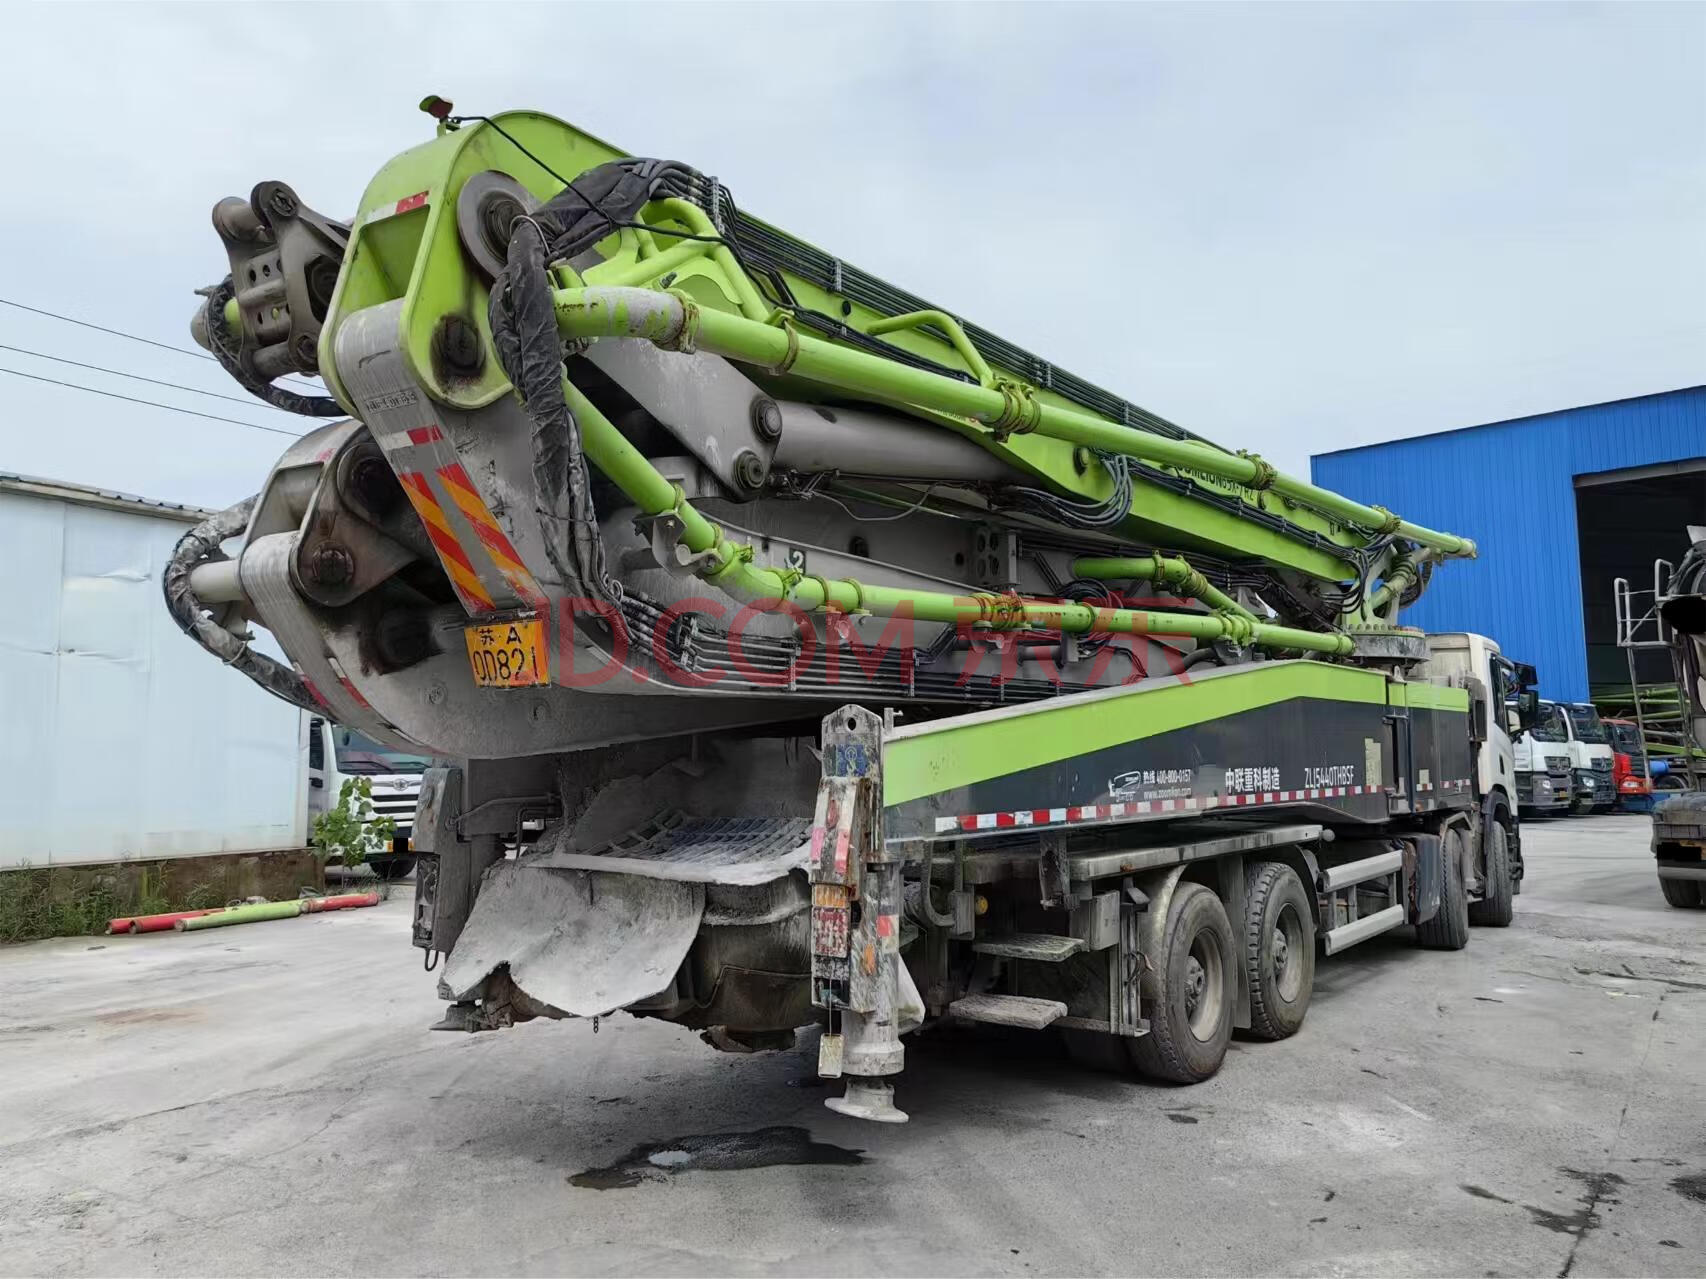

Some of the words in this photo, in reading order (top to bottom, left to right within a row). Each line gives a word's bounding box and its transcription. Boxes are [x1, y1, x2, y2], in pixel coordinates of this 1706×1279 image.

[1225, 767, 1280, 793] 中联重科制造
